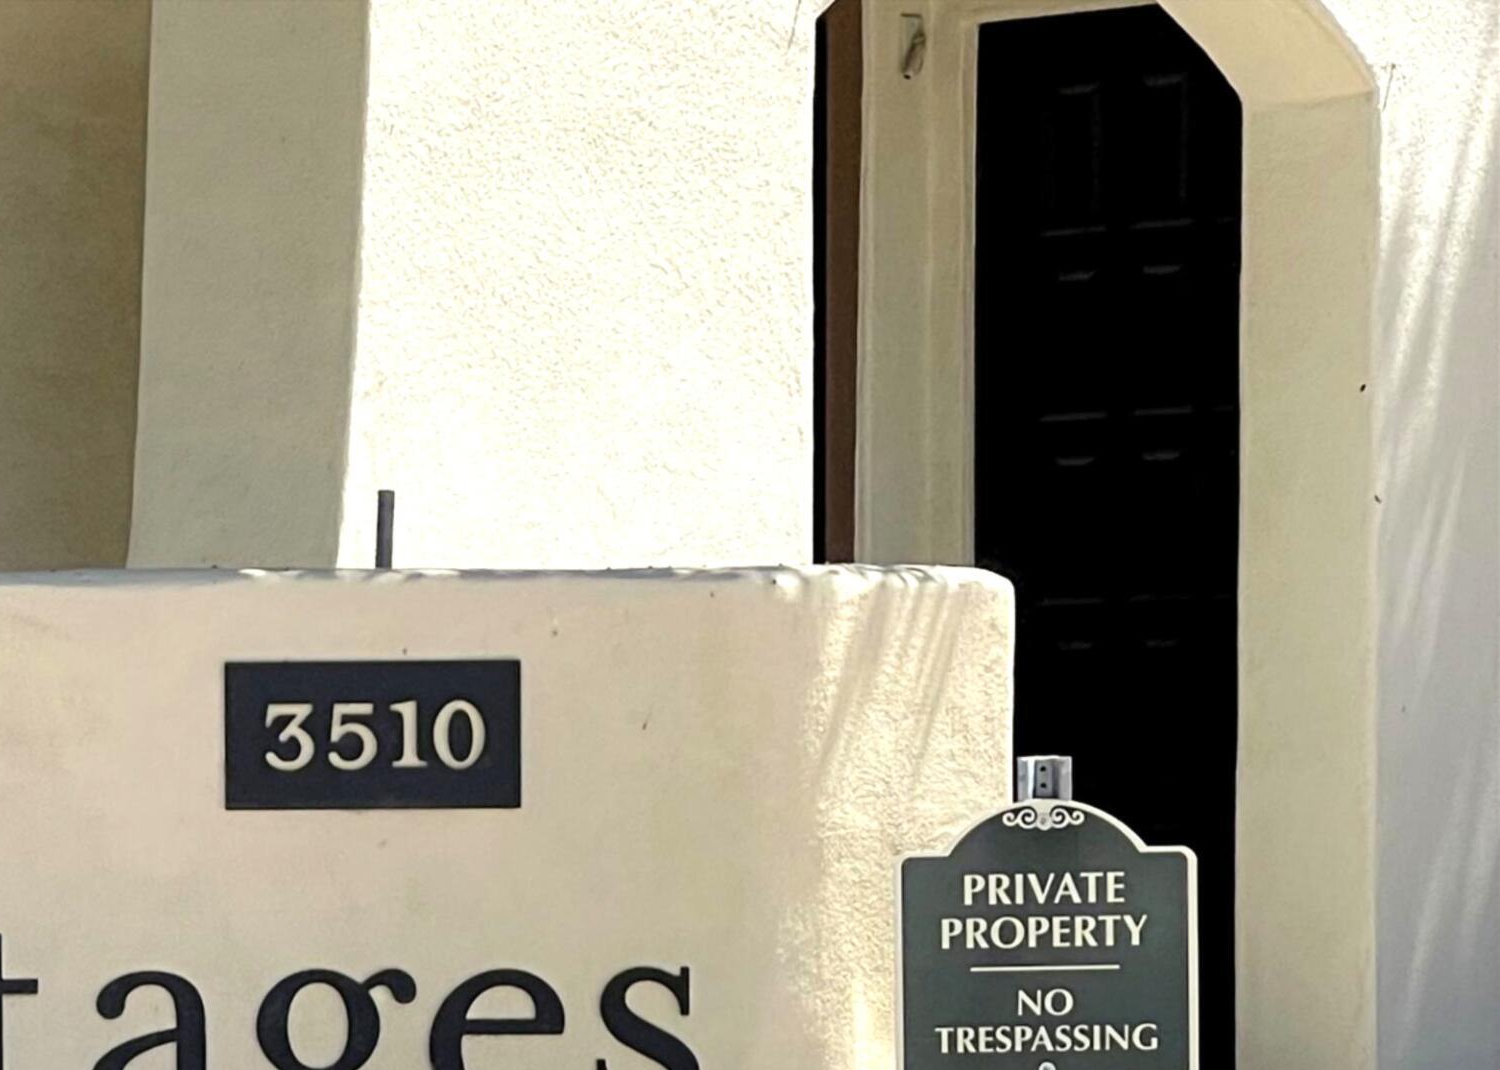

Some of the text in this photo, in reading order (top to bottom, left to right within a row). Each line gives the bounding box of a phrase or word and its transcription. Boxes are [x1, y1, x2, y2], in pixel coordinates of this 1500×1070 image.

[263, 699, 487, 771] 3510
[962, 871, 1126, 906] PRIVATE
[940, 914, 1149, 950] PROPERTY
[1016, 988, 1075, 1017] NO
[934, 1023, 1159, 1054] TRESPASSING
